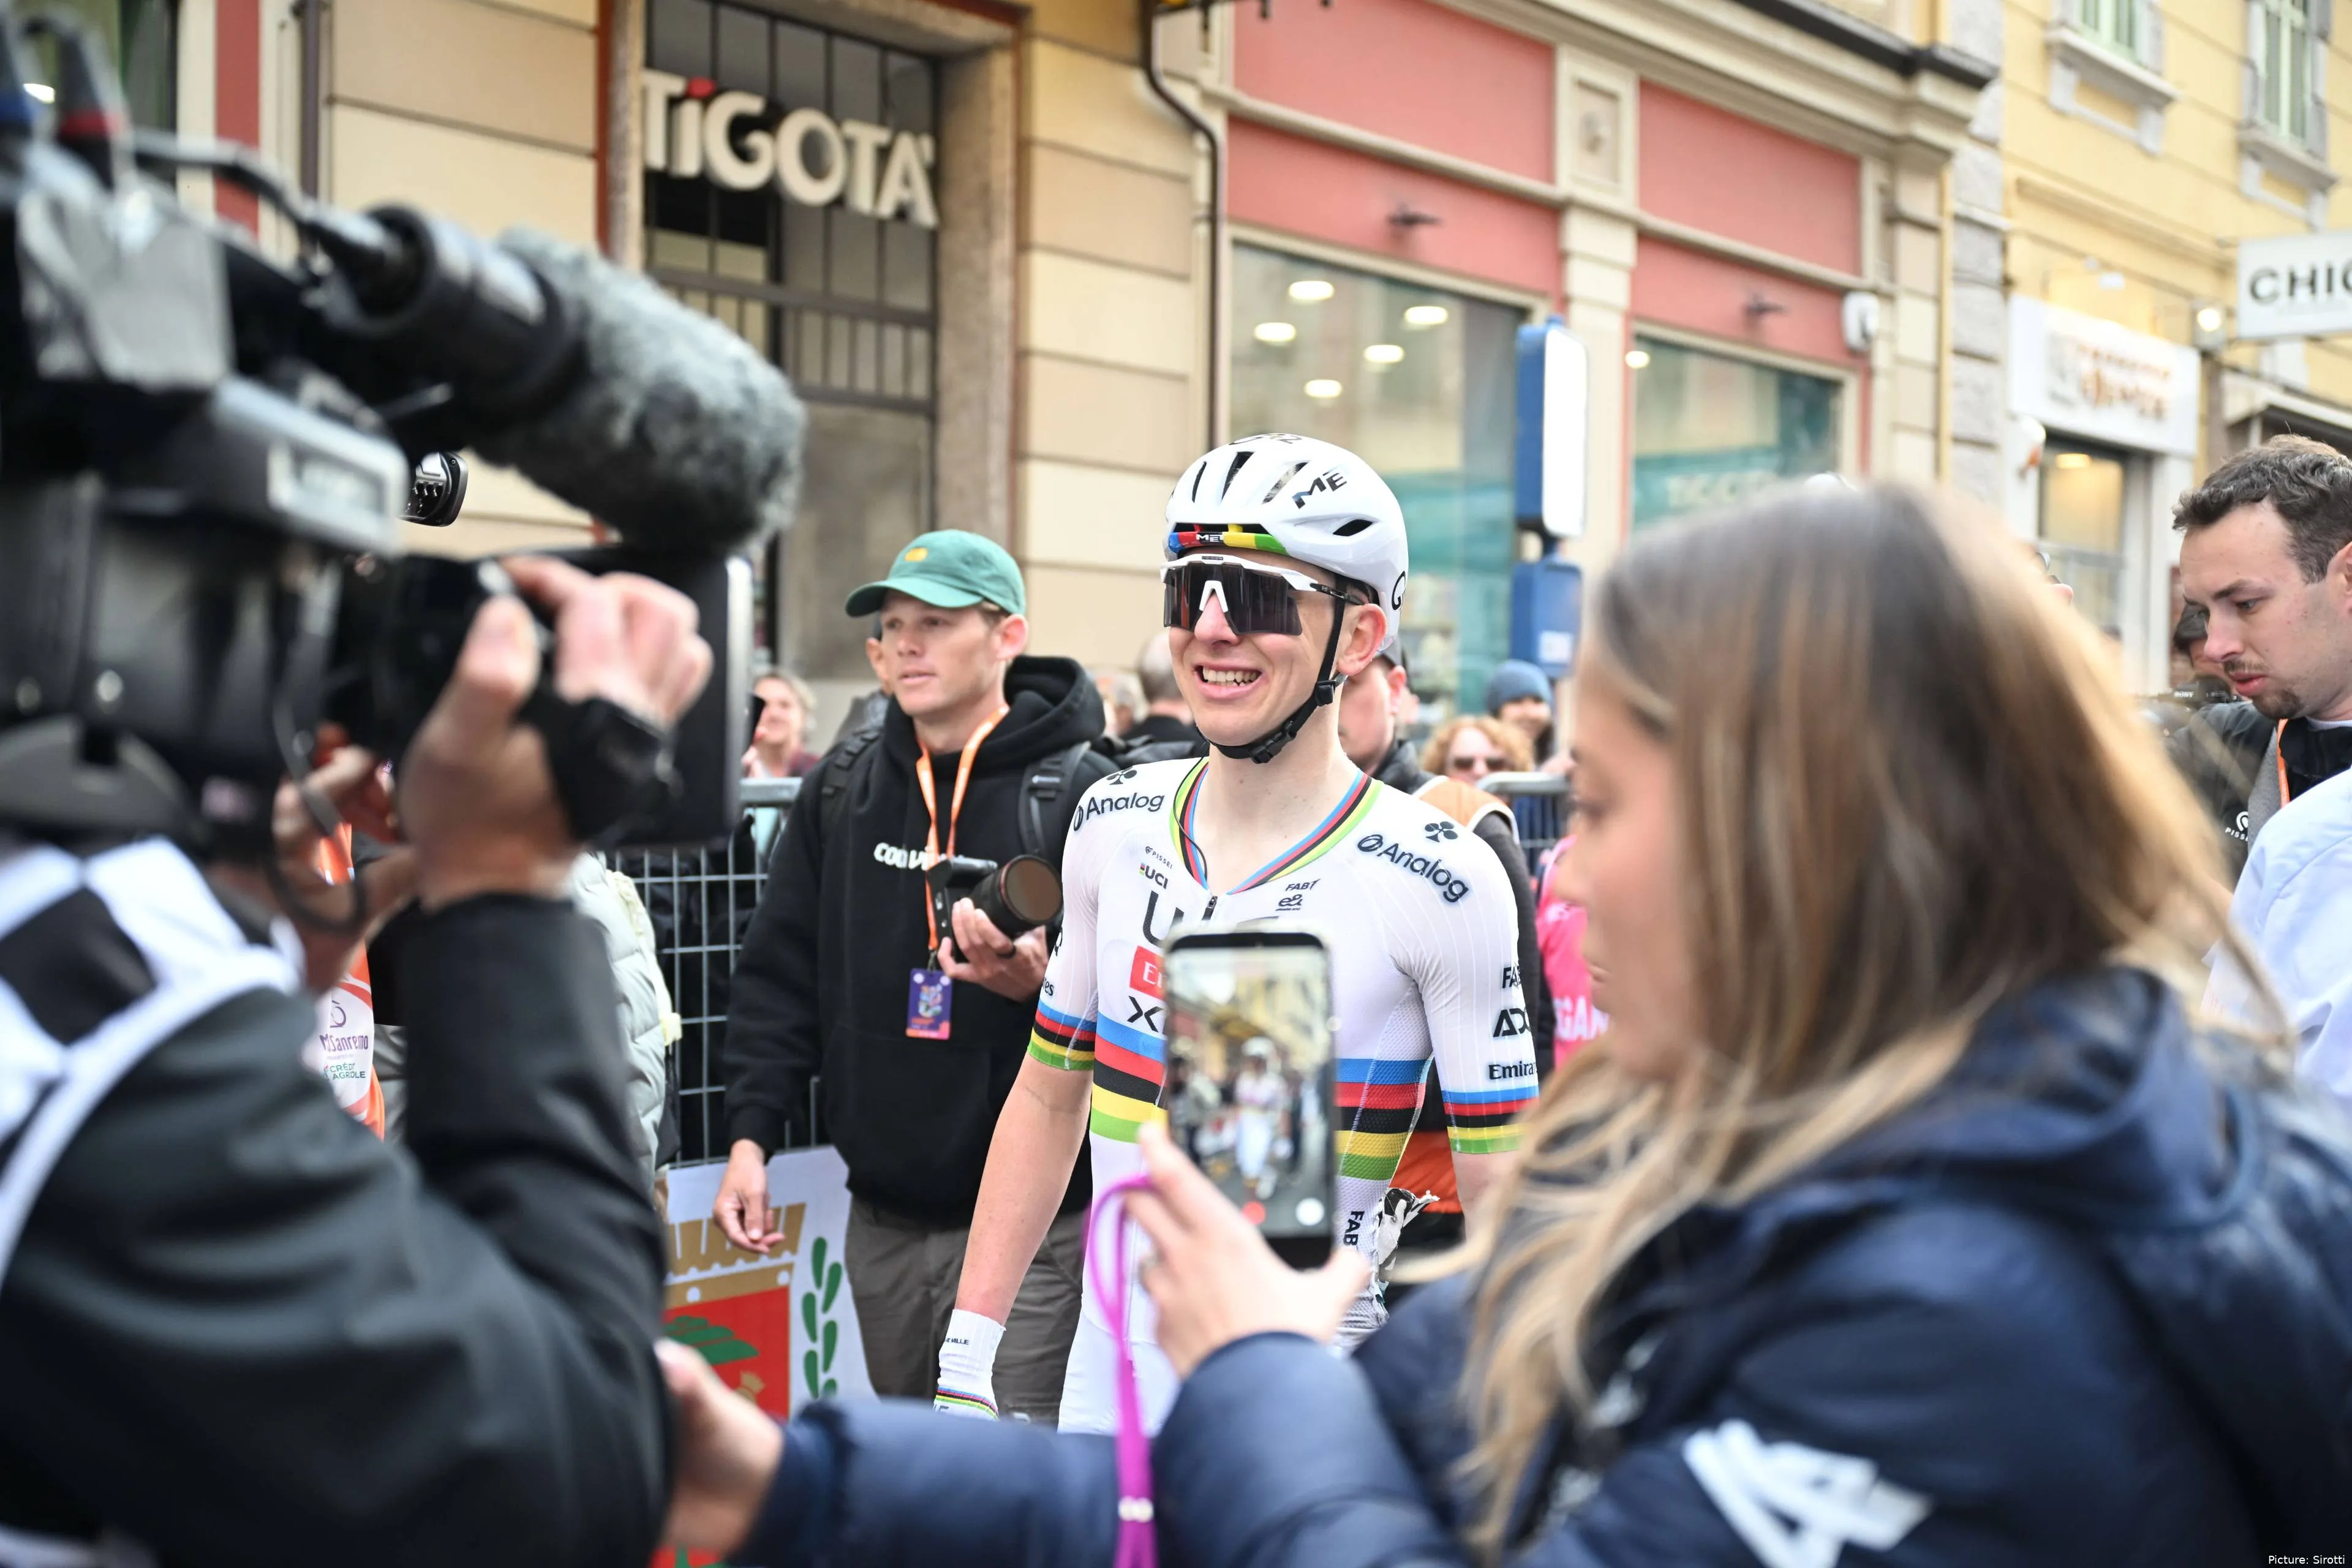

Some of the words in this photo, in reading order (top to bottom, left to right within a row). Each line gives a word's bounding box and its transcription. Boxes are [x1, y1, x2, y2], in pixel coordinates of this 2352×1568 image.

[1086, 793, 1165, 820] Analog
[1152, 851, 1172, 869] PISSEI
[1377, 842, 1469, 903] Analog
[1145, 865, 1169, 889] UCI
